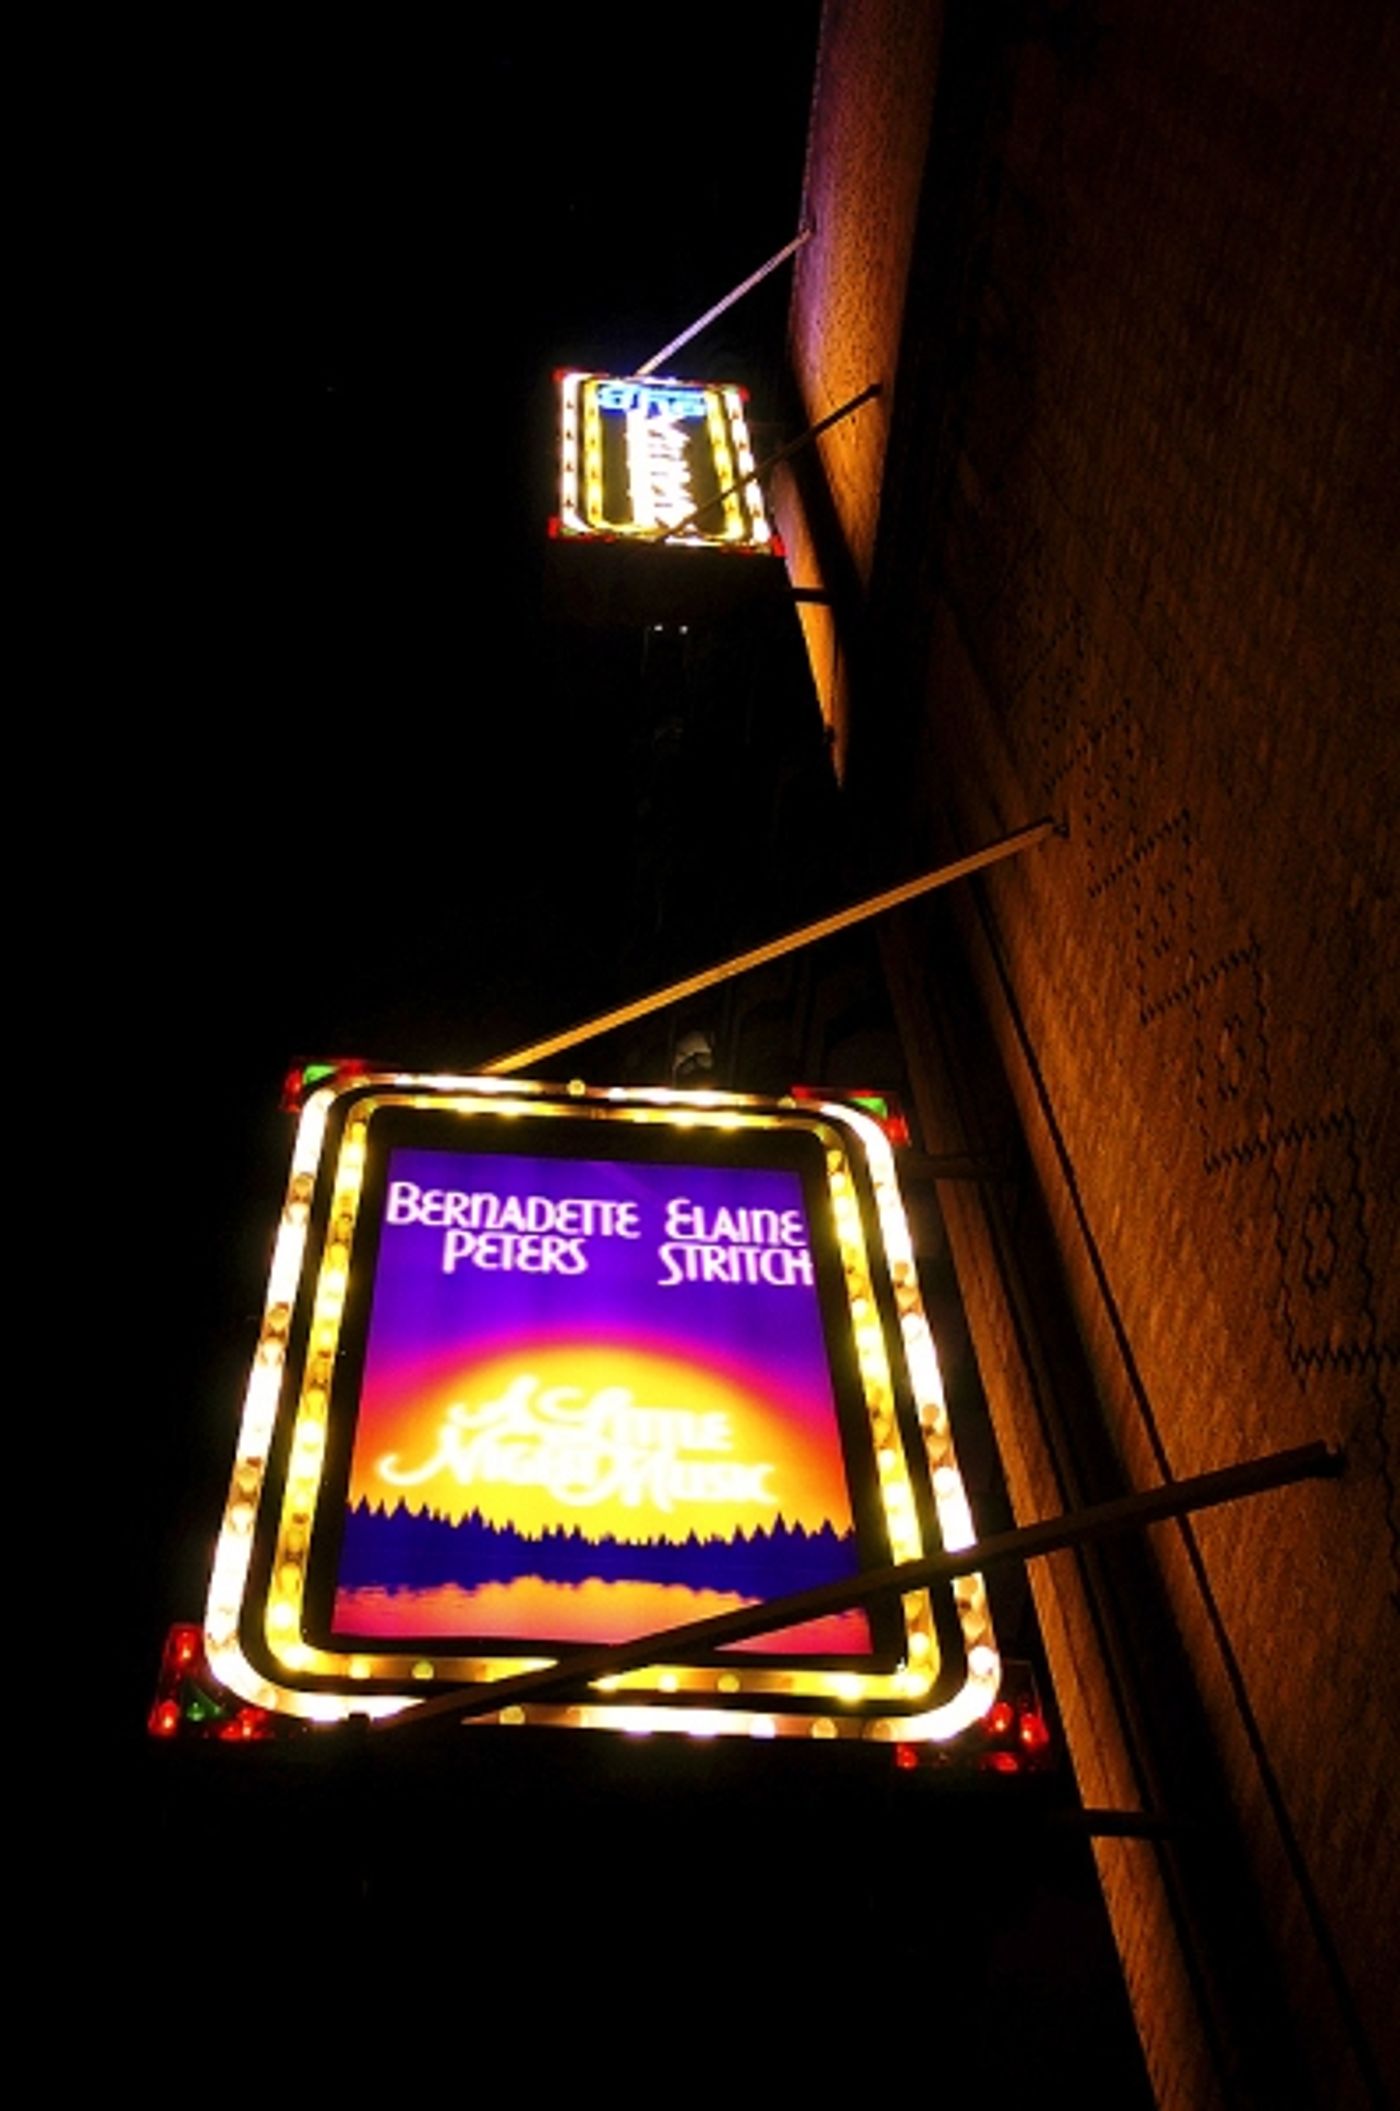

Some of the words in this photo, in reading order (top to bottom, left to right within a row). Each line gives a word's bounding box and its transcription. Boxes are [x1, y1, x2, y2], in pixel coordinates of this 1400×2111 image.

[385, 1180, 641, 1239] BERNADETTE
[664, 1197, 804, 1246] ELAINE
[442, 1228, 589, 1274] PETERS
[657, 1241, 816, 1286] STRITCH
